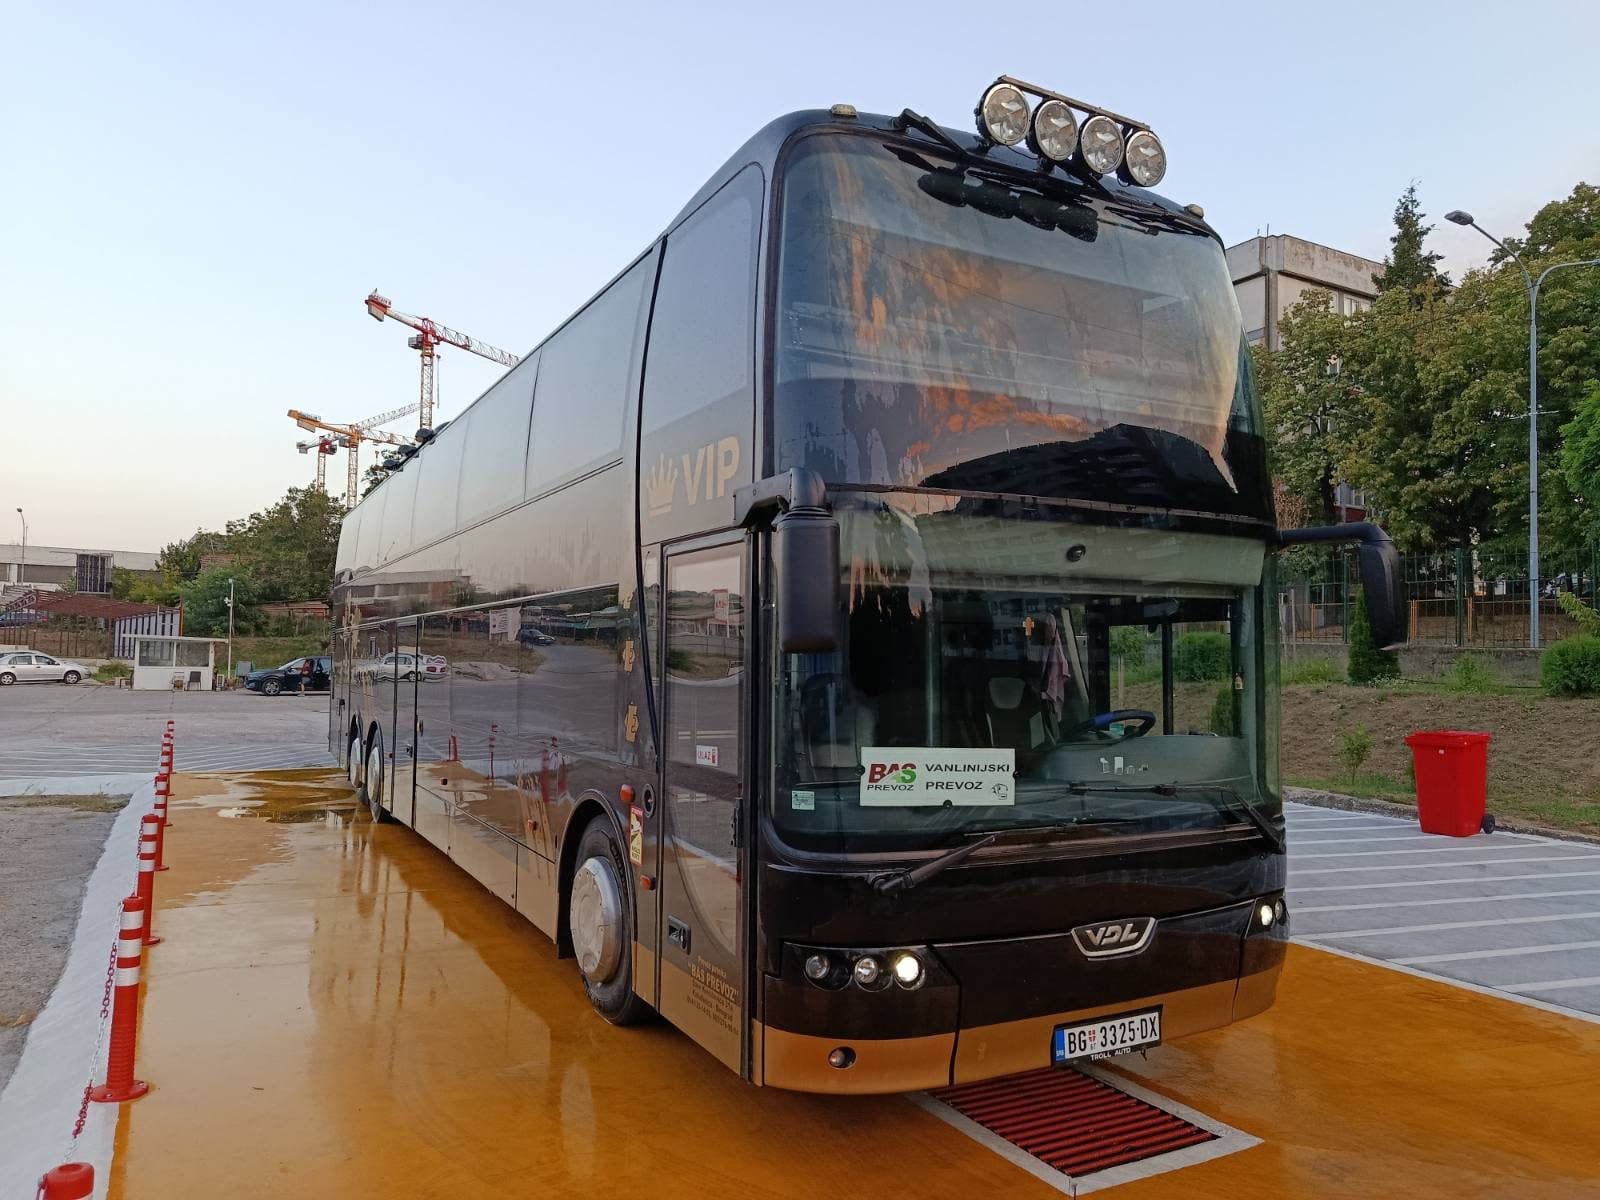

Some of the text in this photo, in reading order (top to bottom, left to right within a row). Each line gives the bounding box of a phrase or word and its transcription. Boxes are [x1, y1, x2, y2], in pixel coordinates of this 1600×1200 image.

[682, 436, 740, 506] VIP
[868, 763, 917, 784] BAS
[925, 764, 1010, 772] VANLINIJSKI
[926, 781, 983, 790] PREVOZ
[1086, 923, 1139, 946] VDL
[1068, 1030, 1087, 1054] BG
[1090, 1047, 1131, 1061] TROLL AUTO
